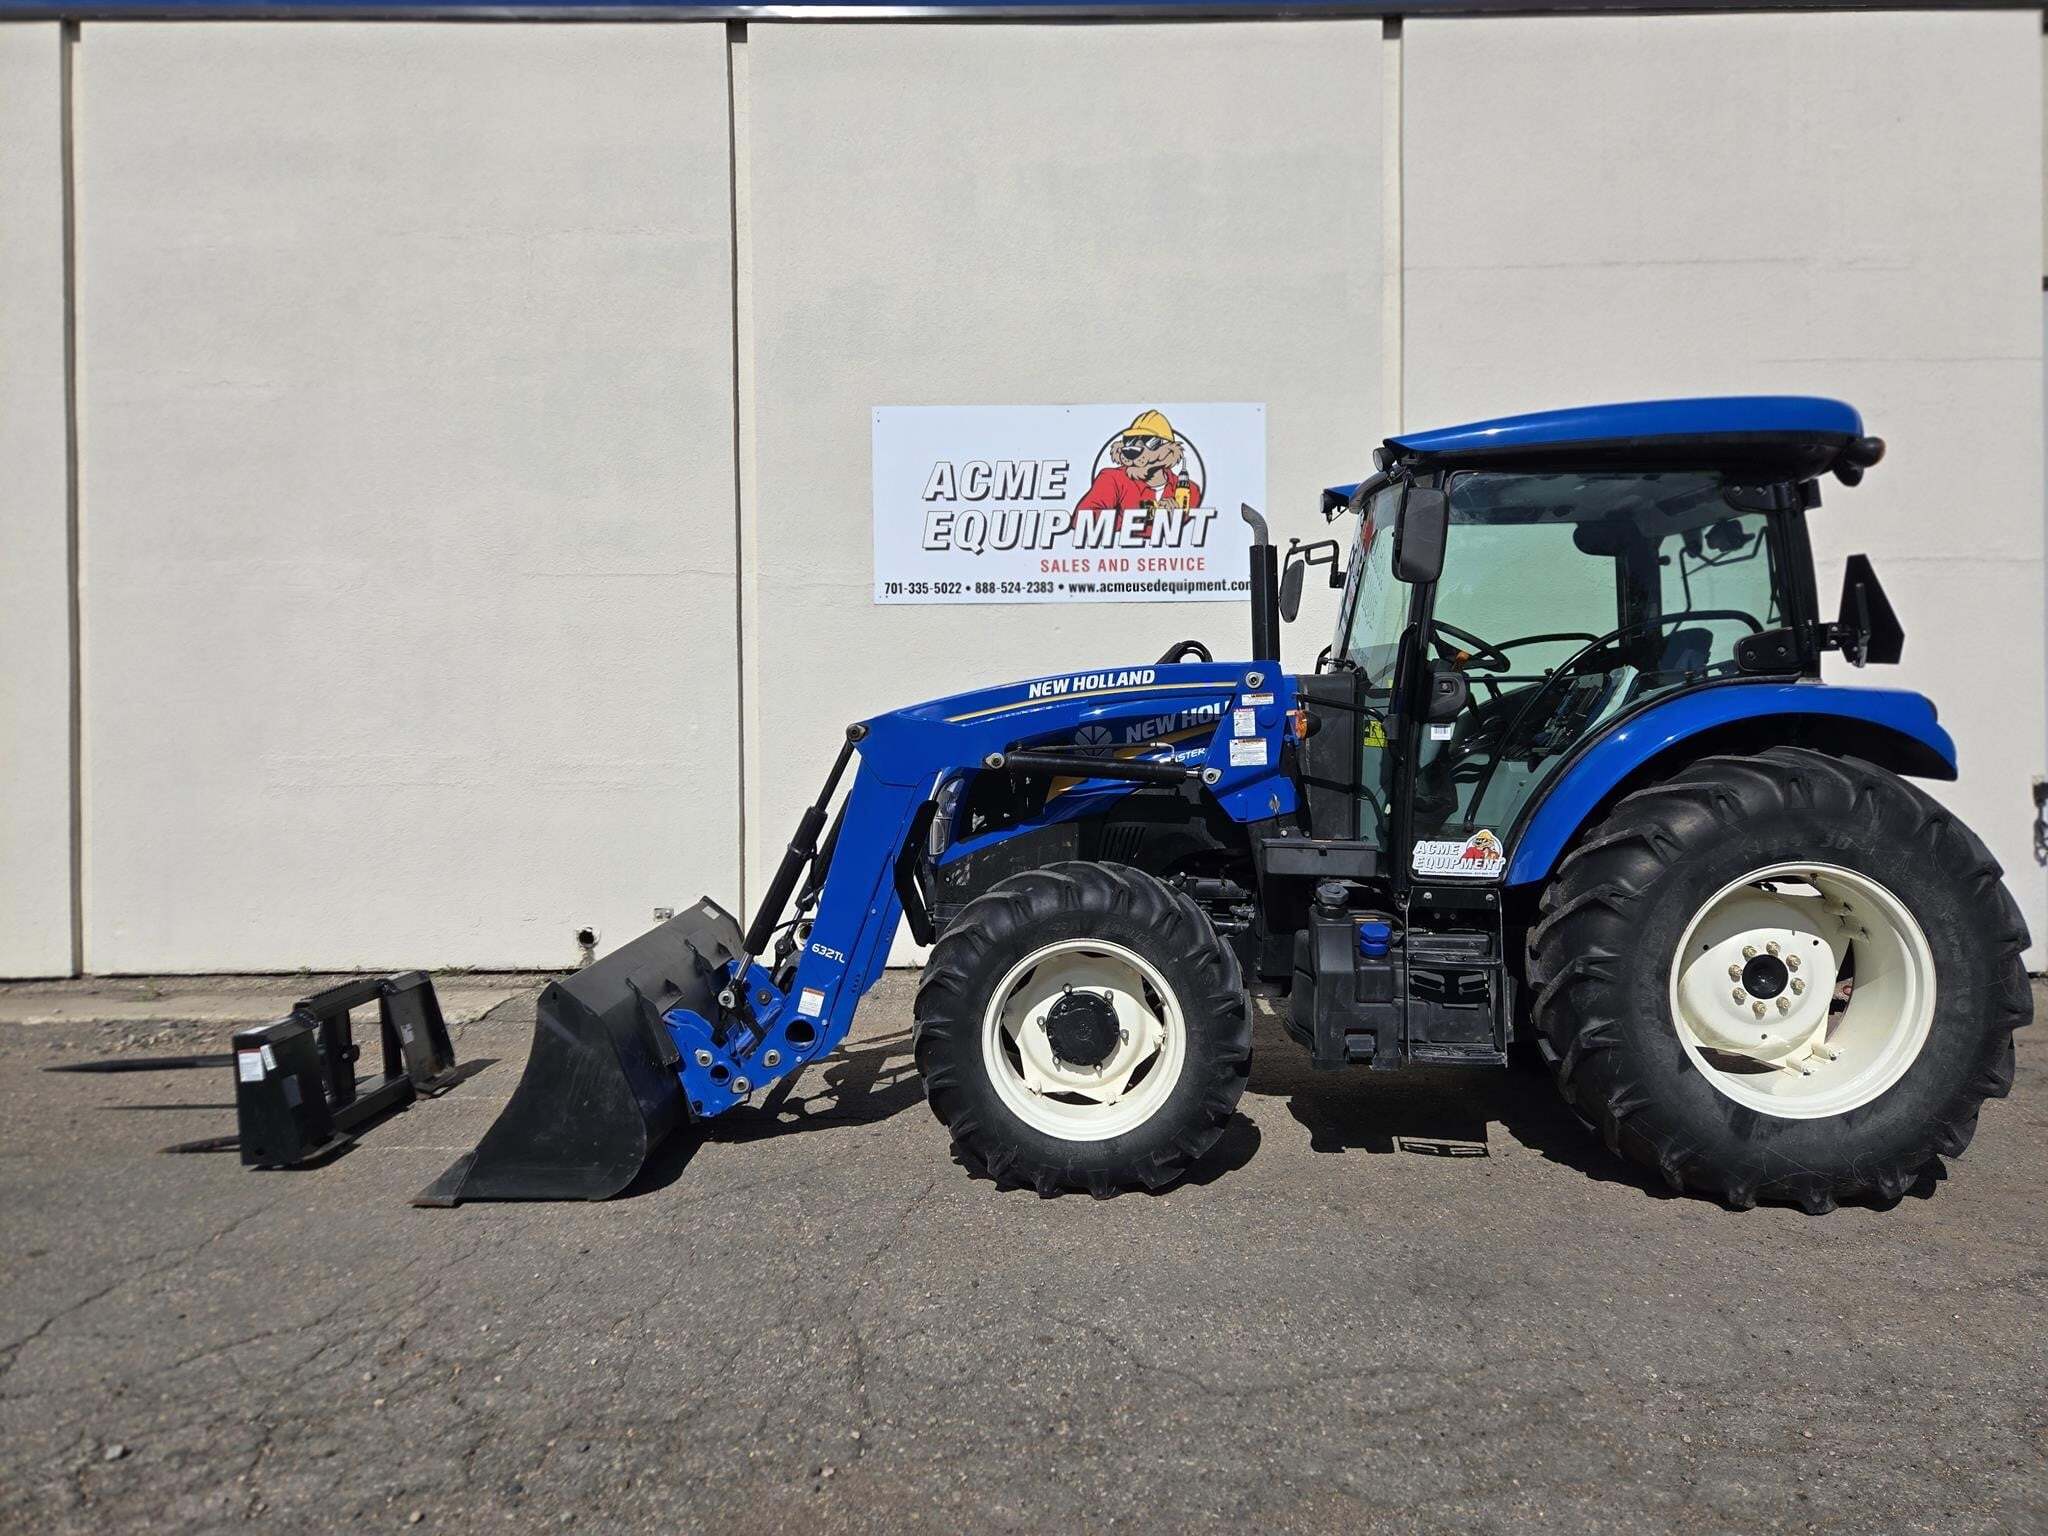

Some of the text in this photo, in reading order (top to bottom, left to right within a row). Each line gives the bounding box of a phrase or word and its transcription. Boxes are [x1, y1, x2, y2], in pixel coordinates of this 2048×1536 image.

[922, 460, 1070, 501] ACME
[922, 506, 1217, 555] EQUIPMENT
[1040, 557, 1205, 573] SALES AND SERVICE
[884, 582, 962, 594] 701-335-5022
[975, 581, 1054, 594] 888-524-2383
[1029, 669, 1156, 699] NEW HOLLAND
[1126, 713, 1177, 744] NEW
[1415, 841, 1461, 856] ACME
[1415, 856, 1506, 871] EQUIPMENT
[811, 943, 845, 964] 632TL
